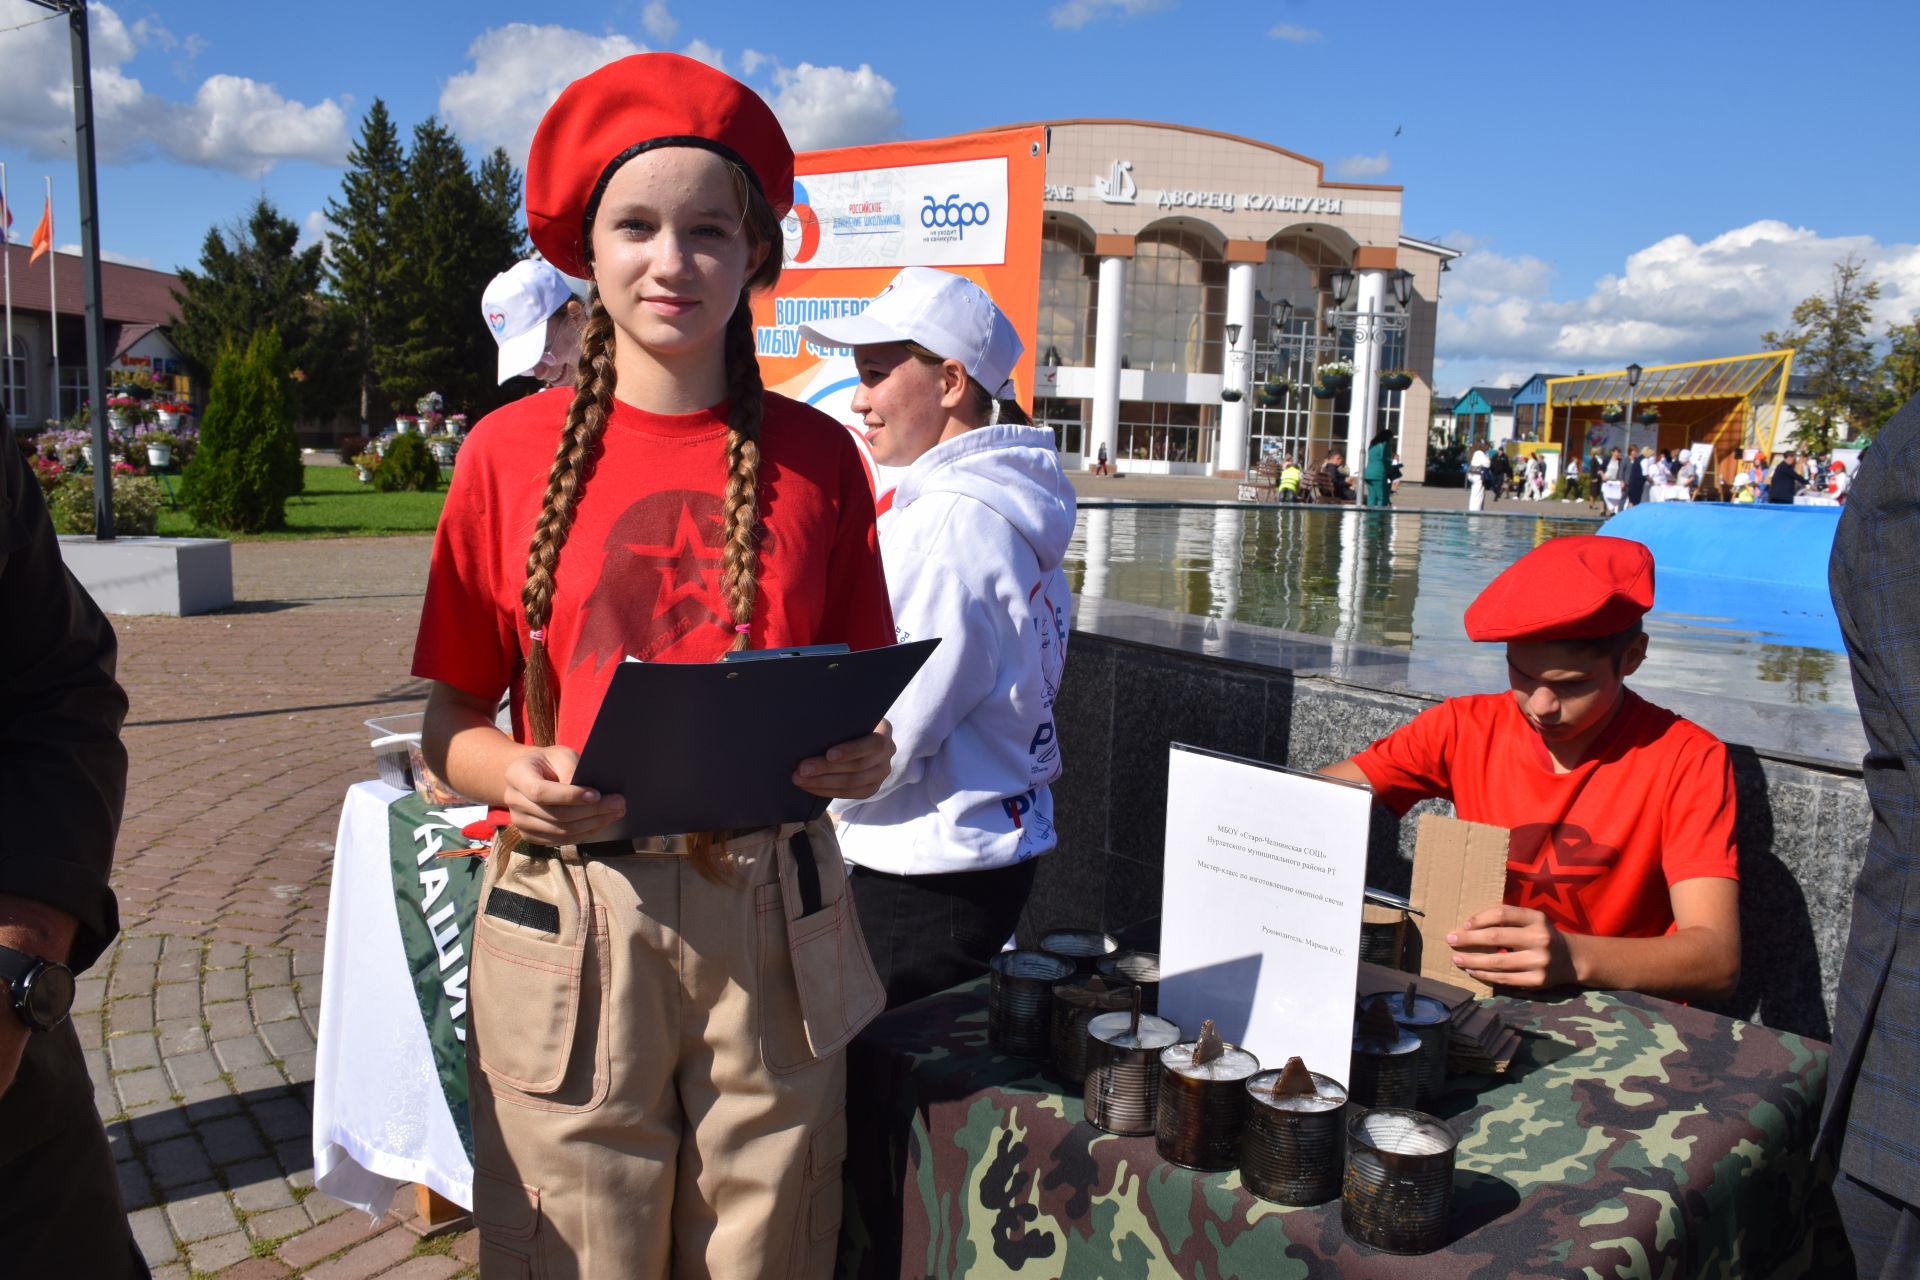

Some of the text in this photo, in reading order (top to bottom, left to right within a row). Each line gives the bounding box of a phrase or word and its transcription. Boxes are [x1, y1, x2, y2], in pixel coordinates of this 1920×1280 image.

[849, 200, 882, 214] РОССИЙСКОЕ
[920, 193, 990, 241] добро
[1159, 190, 1343, 215] ДВОРЕЦ КУЛЬТУРЫ
[864, 214, 901, 227] ШКОЛЬНИКОВ
[757, 328, 800, 355] МБОУ
[1207, 835, 1337, 877] Нурлатского муниципального района РТ
[1217, 825, 1240, 836] МБОУ
[1303, 847, 1328, 860] СОШ»
[1197, 860, 1239, 878] Мастер-класс
[1239, 872, 1248, 881] по
[1249, 876, 1294, 893] изготовлению
[1324, 896, 1344, 908] свечи
[413, 822, 468, 1042] НАШИ
